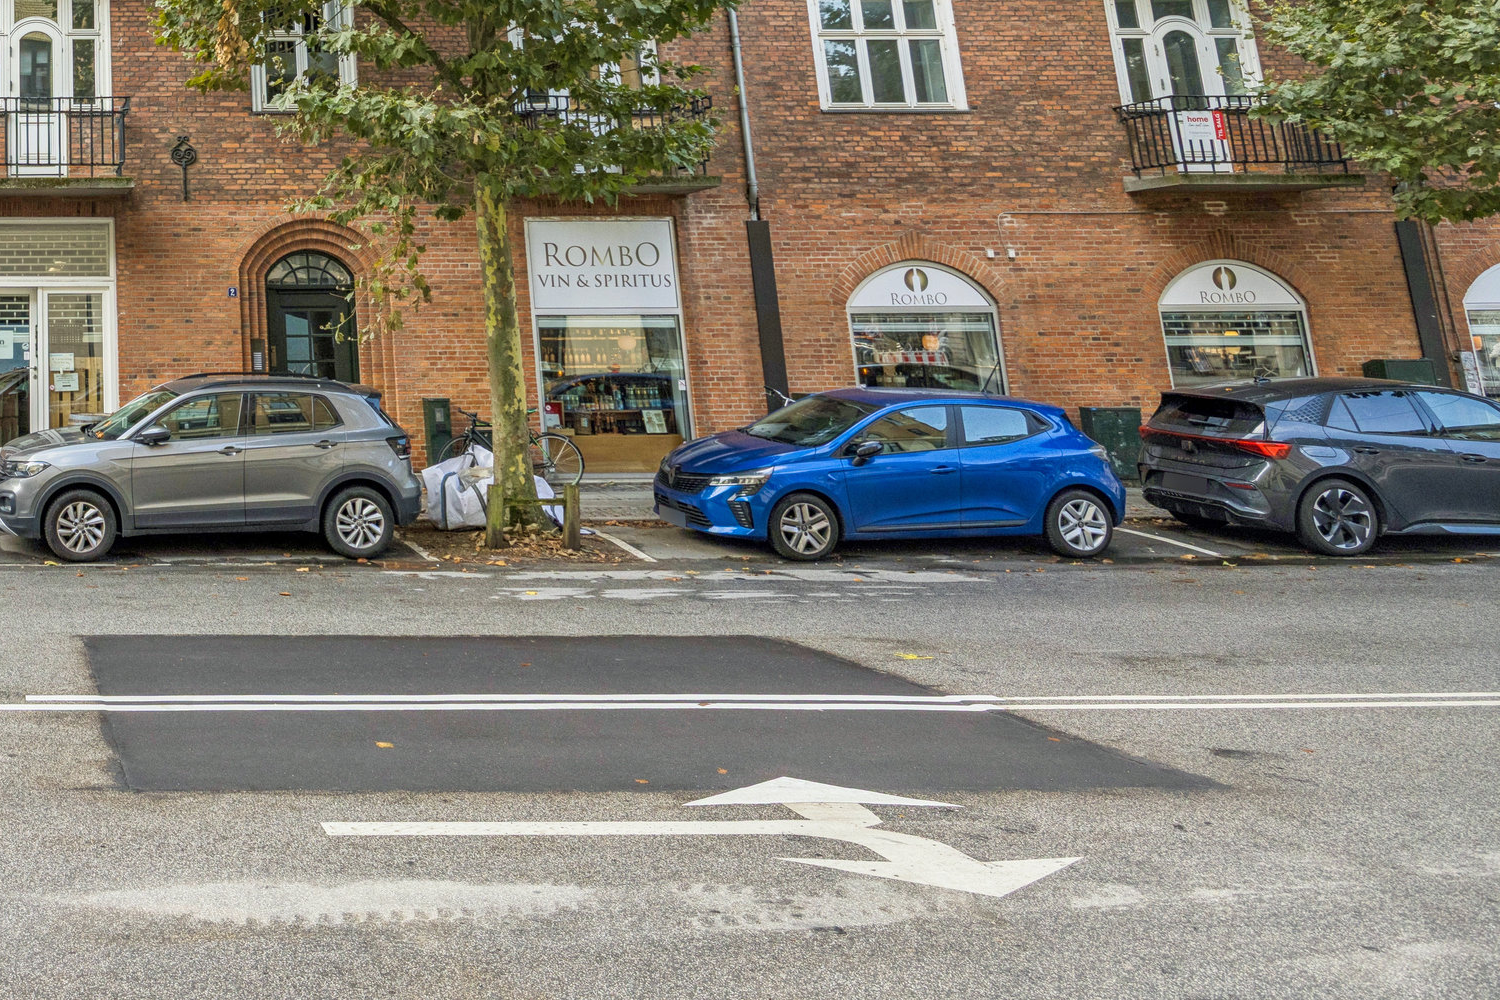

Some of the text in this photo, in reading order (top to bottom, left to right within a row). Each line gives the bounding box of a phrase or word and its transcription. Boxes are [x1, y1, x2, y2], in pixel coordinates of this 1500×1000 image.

[1214, 113, 1222, 128] SALG
[543, 242, 660, 267] ROMBO
[538, 274, 672, 288] VIN & SPIRITUS
[230, 288, 235, 296] 2
[891, 292, 947, 305] ROMBO
[1200, 290, 1256, 303] ROMBO
